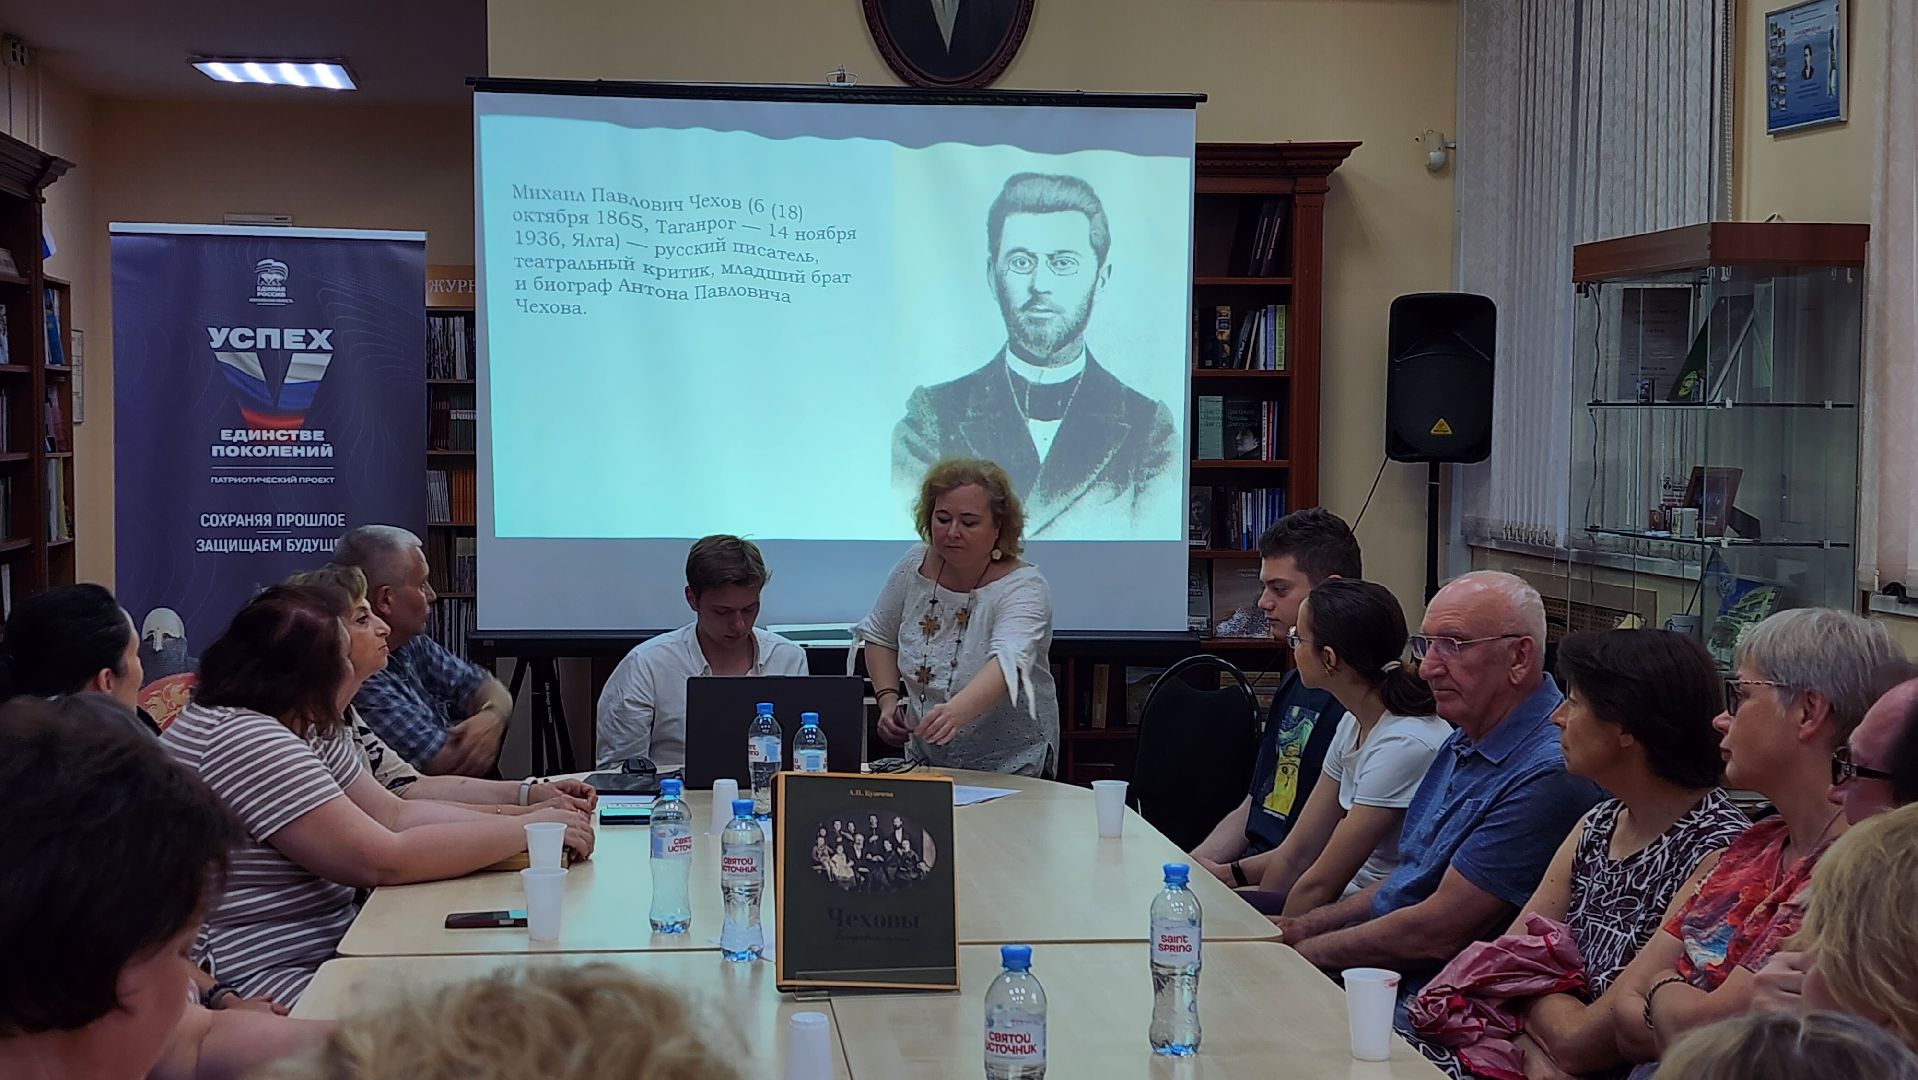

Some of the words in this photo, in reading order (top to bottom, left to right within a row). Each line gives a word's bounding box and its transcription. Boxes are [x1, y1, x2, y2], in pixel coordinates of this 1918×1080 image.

[512, 184, 586, 202] Михаил
[592, 187, 684, 212] Павлович
[689, 194, 742, 210] Чехов
[749, 197, 765, 215] (6
[771, 203, 803, 223] (18)
[513, 209, 589, 227] октября
[597, 210, 649, 233] 1865,
[656, 218, 736, 234] Таганрог
[769, 223, 789, 239] 14
[795, 225, 857, 244] ноября
[515, 230, 565, 249] 1936,
[572, 233, 620, 251] Ялта)
[654, 236, 726, 260] русский
[732, 241, 819, 264] писатель,
[514, 256, 636, 273] театральный
[643, 263, 715, 281] критик,
[721, 263, 806, 284] младший
[811, 270, 852, 287] брат
[515, 279, 527, 291] и
[533, 276, 613, 296] биограф
[618, 278, 689, 301] Антона
[694, 285, 792, 303] Павловича
[515, 298, 587, 315] Чехова.
[207, 327, 334, 350] УСПЕХ
[220, 429, 325, 442] ЕДИНСТВЕ
[211, 444, 334, 458] ПОКОЛЕНИЙ
[210, 475, 297, 484] ПАТРИОТИЧЕСКИЙ
[298, 476, 335, 484] ПРОЕКТ
[200, 513, 272, 527] СОХРАНЯЯ
[276, 513, 346, 527] ПРОШЛОЕ
[195, 538, 282, 553] ЗАЩИЩАЕМ
[827, 907, 920, 929] Чеховы
[989, 1031, 1031, 1044] СВЯТОЙ
